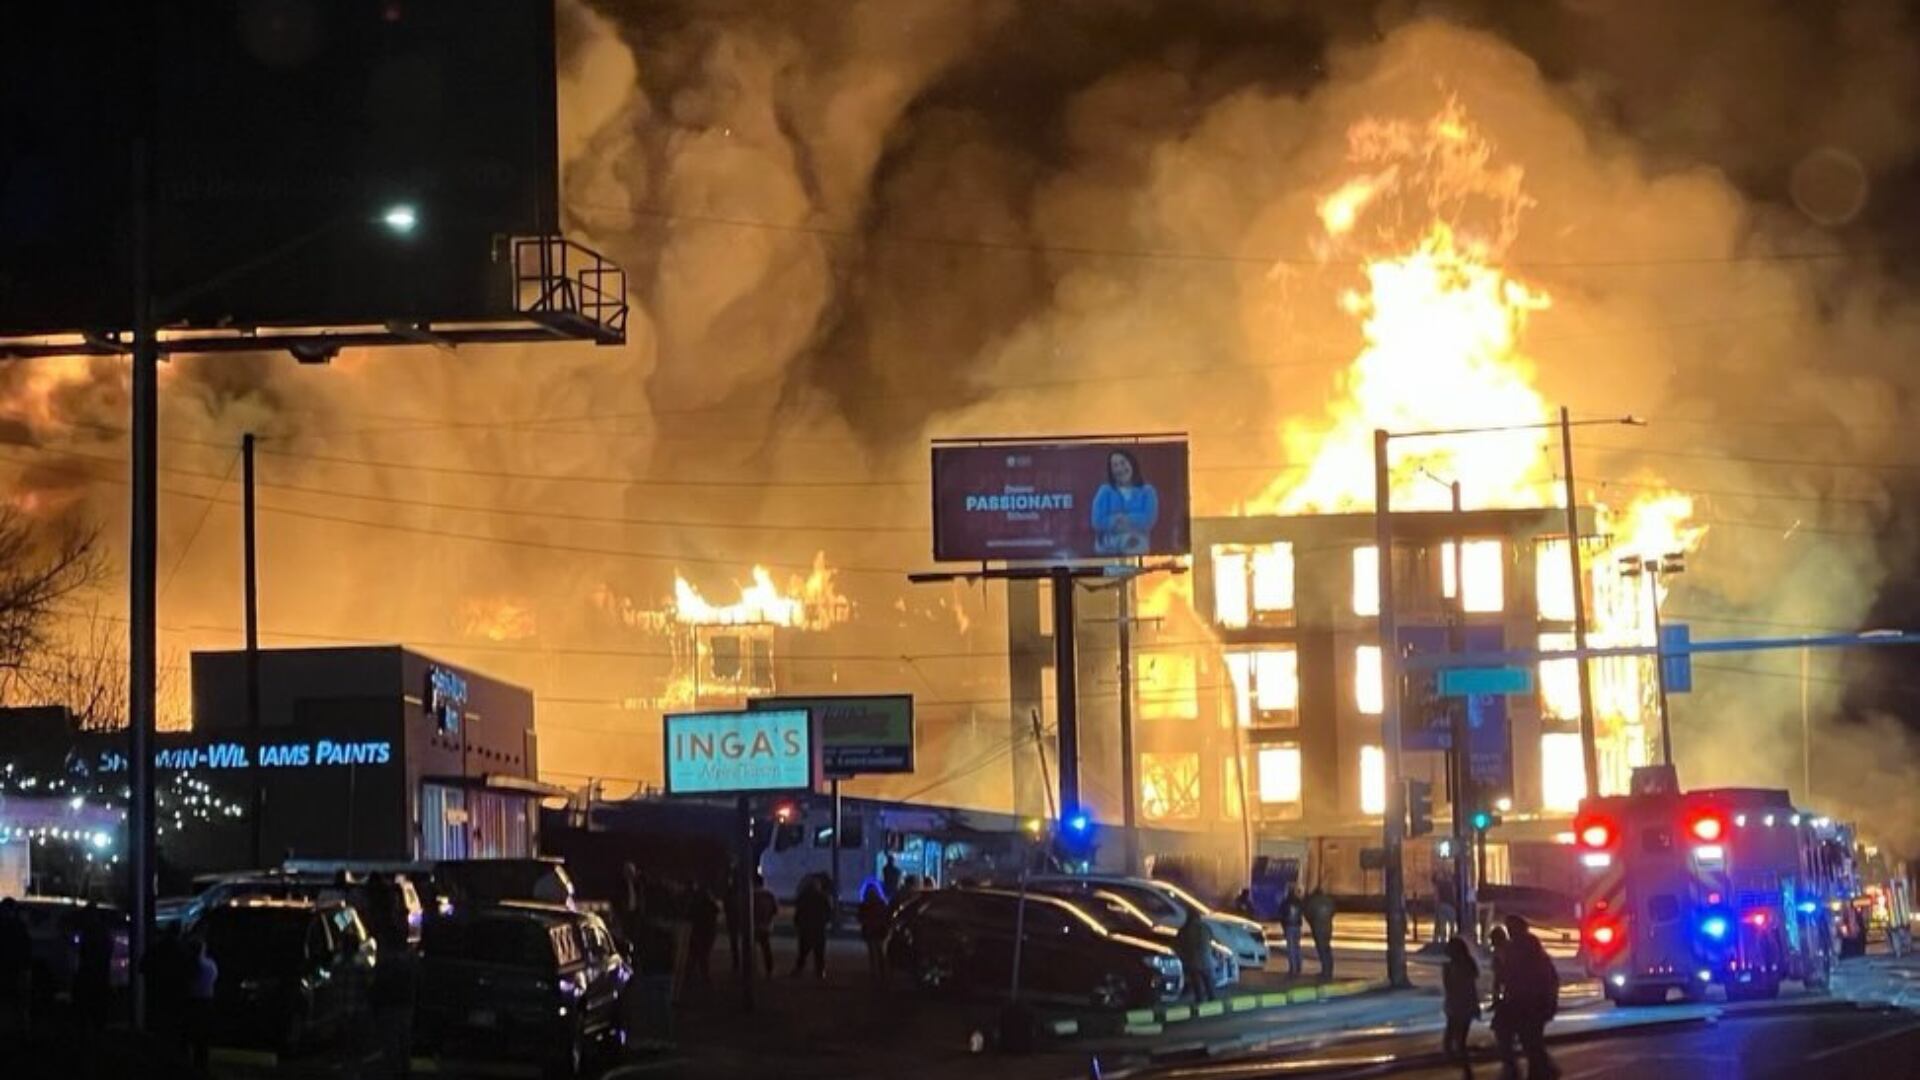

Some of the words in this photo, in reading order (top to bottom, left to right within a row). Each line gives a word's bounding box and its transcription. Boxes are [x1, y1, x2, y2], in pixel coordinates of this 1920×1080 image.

[966, 494, 1073, 511] PASSIONATE
[97, 743, 310, 771] SHWIN-WILIAMS
[315, 740, 390, 765] PAINTS
[675, 727, 801, 761] INGA'S
